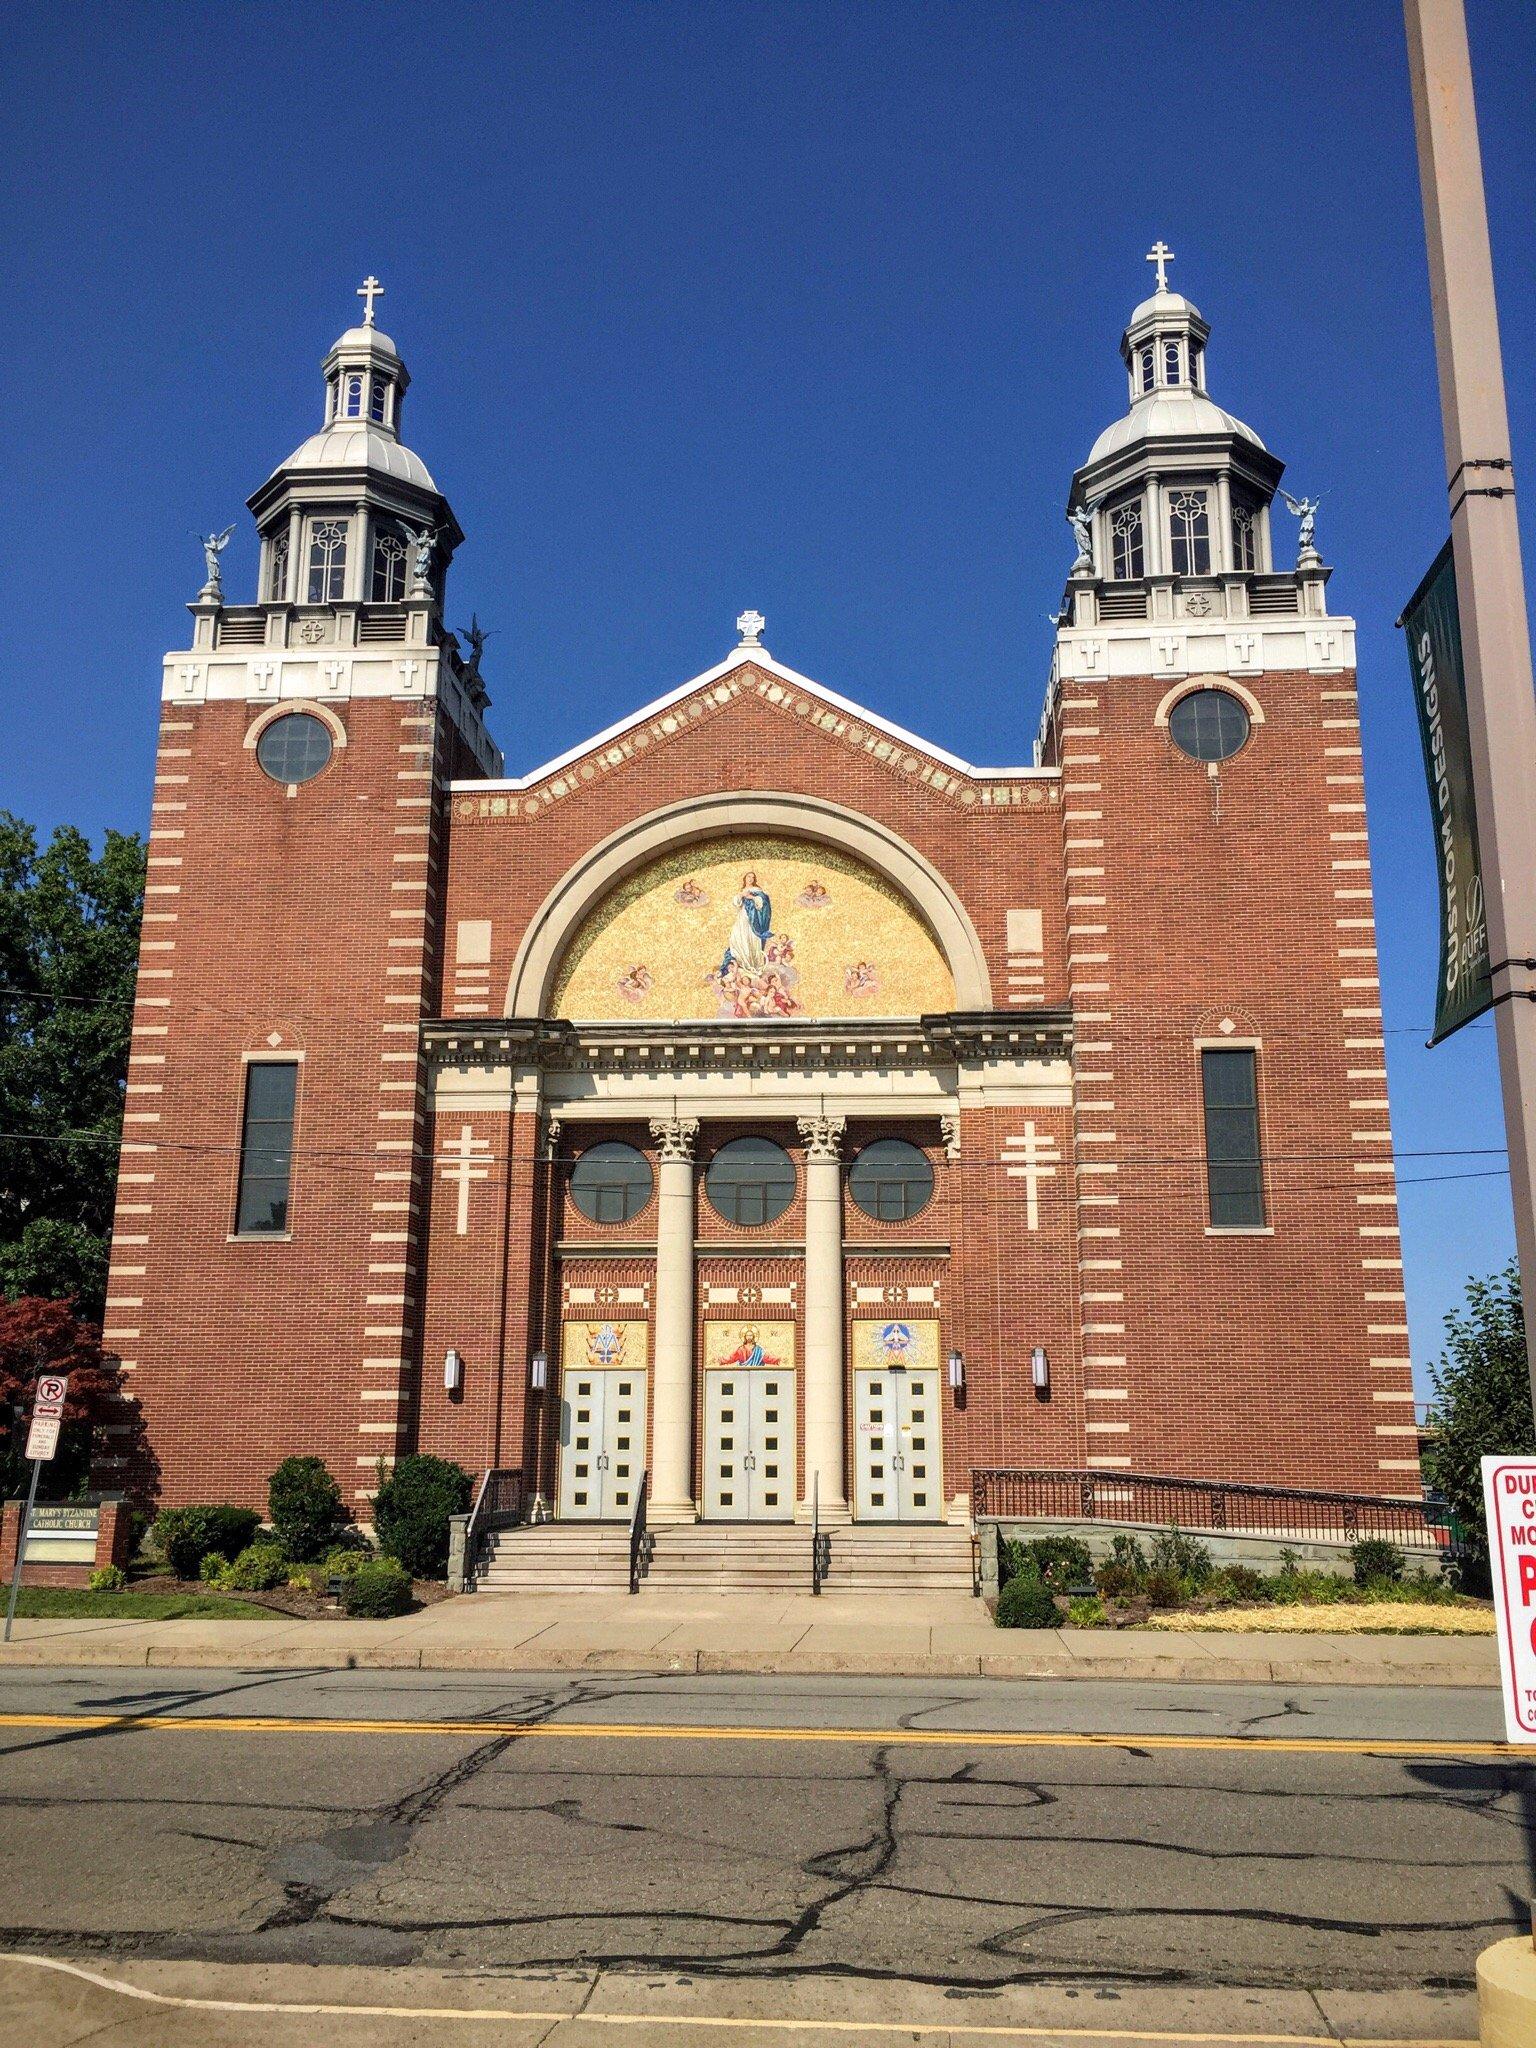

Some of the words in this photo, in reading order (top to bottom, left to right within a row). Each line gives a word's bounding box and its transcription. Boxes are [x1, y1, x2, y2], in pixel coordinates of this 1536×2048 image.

[1417, 631, 1450, 811] DESIGNS
[1441, 814, 1459, 991] CUSTOM
[1461, 923, 1486, 965] DUFF
[33, 1519, 63, 1528] CATHOLIC
[64, 1519, 91, 1529] CHURCH
[63, 1508, 98, 1518] BYZANTINE
